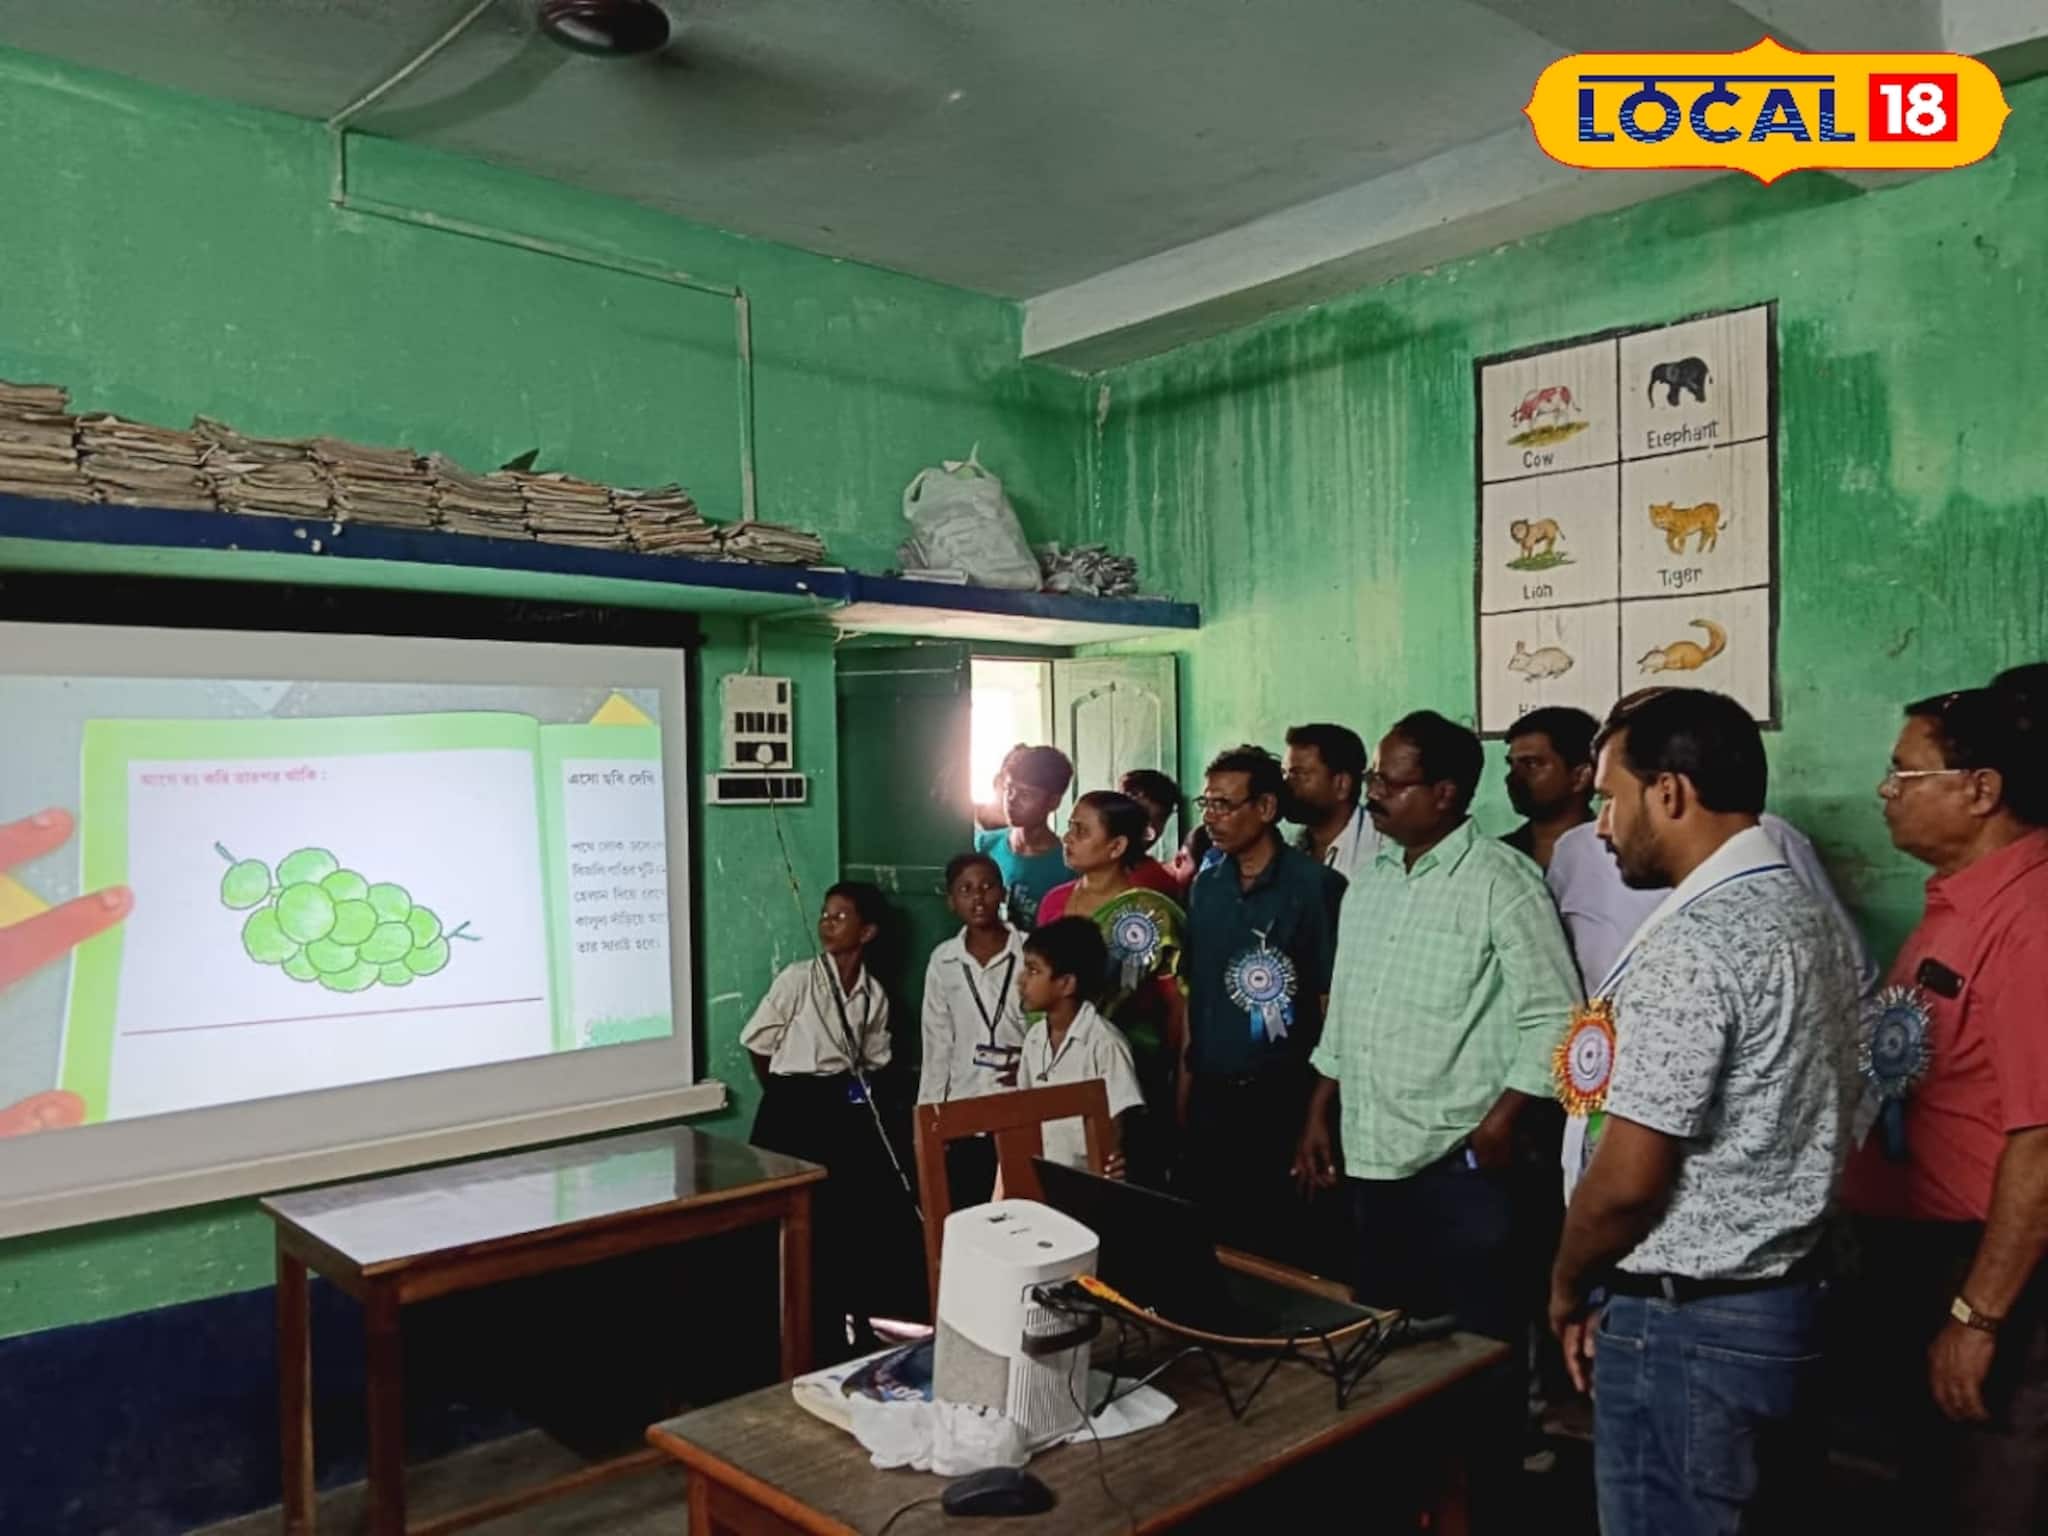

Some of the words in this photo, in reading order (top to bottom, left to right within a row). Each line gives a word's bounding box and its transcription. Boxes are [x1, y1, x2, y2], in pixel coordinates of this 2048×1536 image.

[1646, 419, 1720, 450] Elephant
[1522, 450, 1556, 469] Cow
[1657, 567, 1704, 589] Tiger
[1522, 583, 1554, 600] Lion
